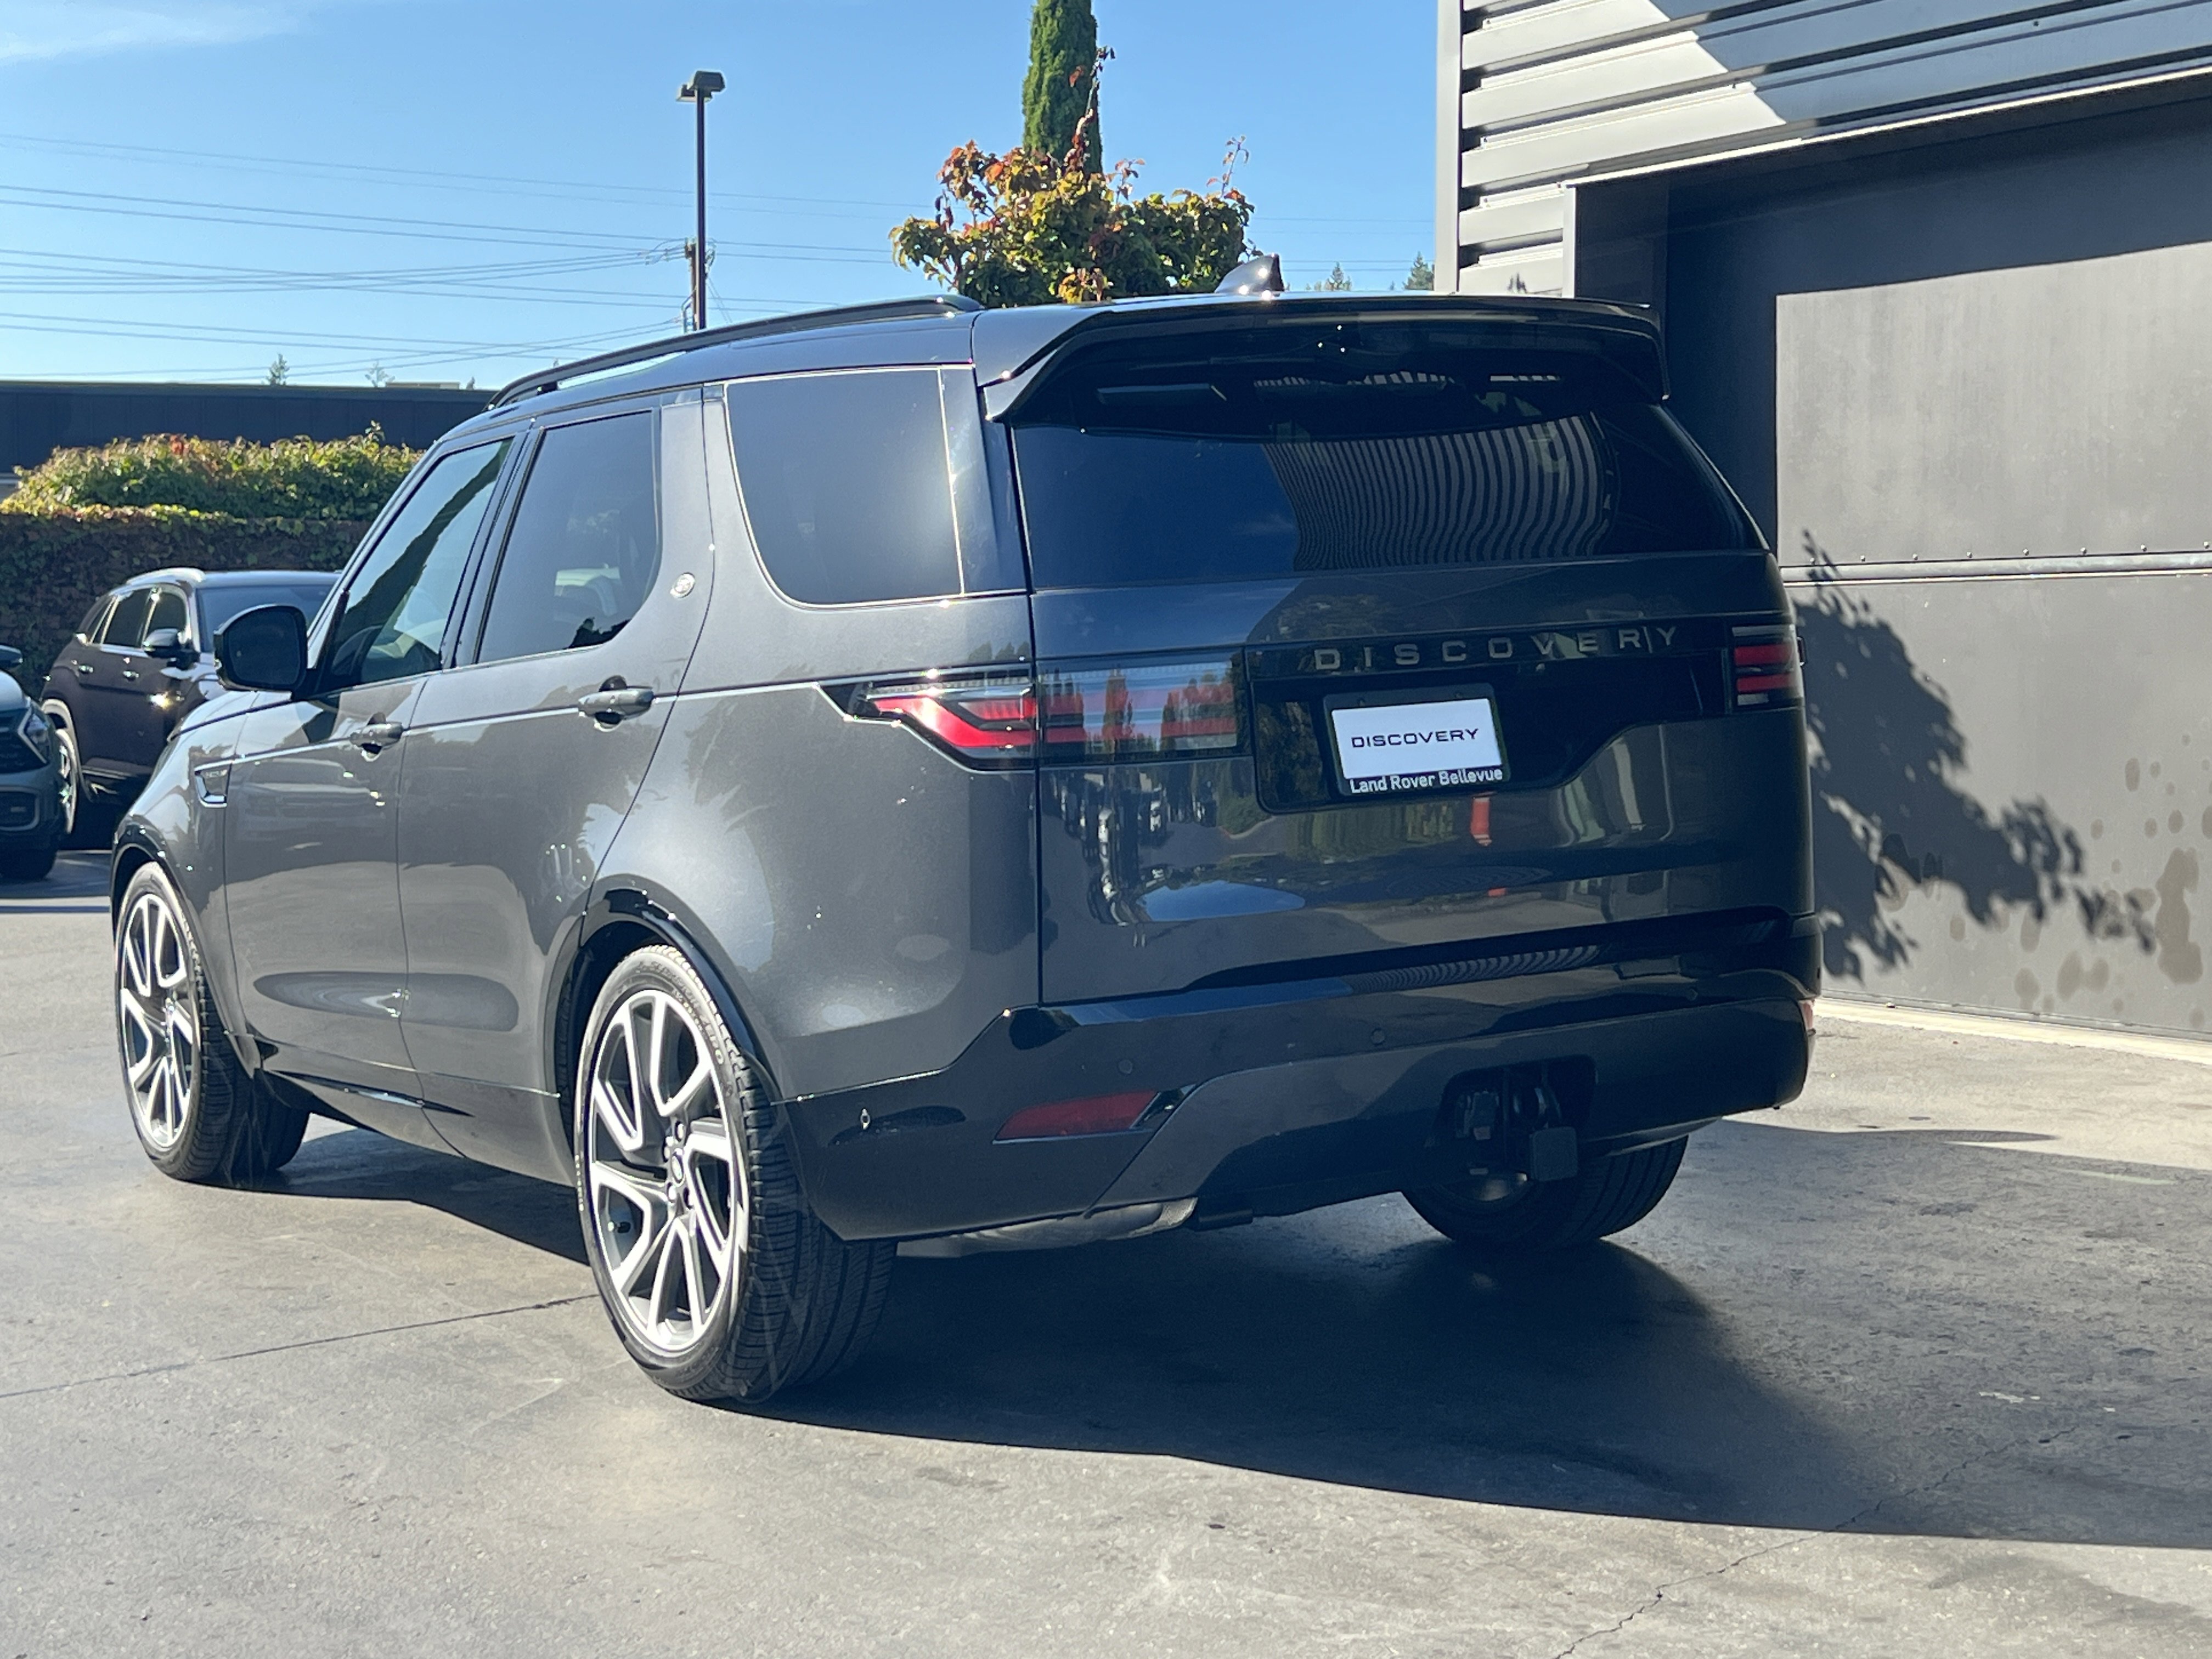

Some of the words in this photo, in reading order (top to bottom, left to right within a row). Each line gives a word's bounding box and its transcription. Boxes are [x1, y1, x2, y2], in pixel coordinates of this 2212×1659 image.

[1314, 627, 1676, 670] DISCOVERY
[1351, 728, 1479, 748] DISCOVERY
[1350, 775, 1388, 793] Land
[1390, 774, 1436, 790] Rover
[1438, 768, 1503, 786] Bellevue
